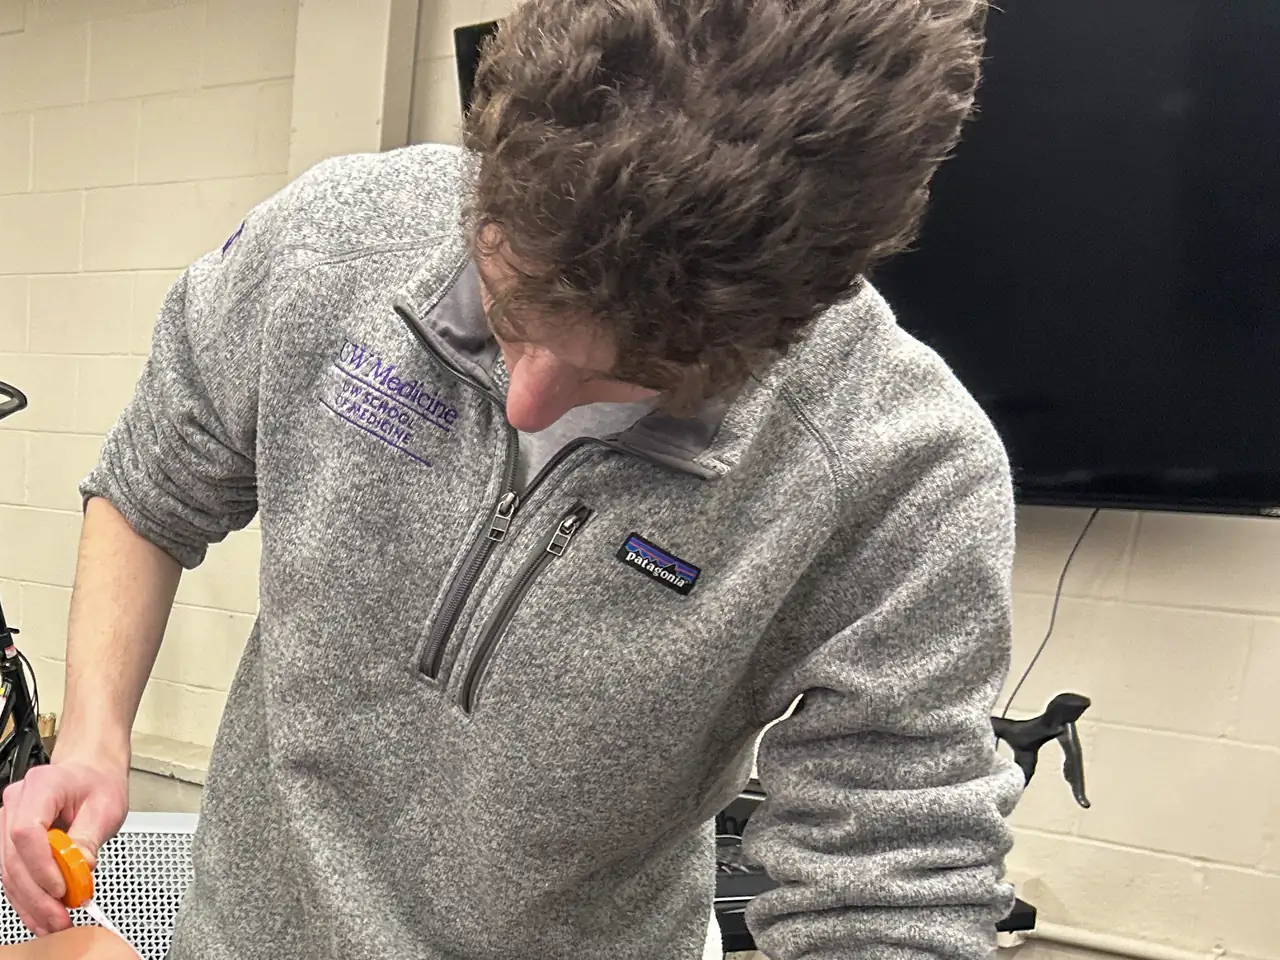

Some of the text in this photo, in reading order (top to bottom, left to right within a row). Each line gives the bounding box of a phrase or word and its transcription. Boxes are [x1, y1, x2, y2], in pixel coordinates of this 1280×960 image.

[340, 339, 458, 425] UW Medicine
[347, 402, 412, 445] MEDICINE
[363, 391, 414, 429] SCHOOL
[625, 551, 686, 588] patagonia
